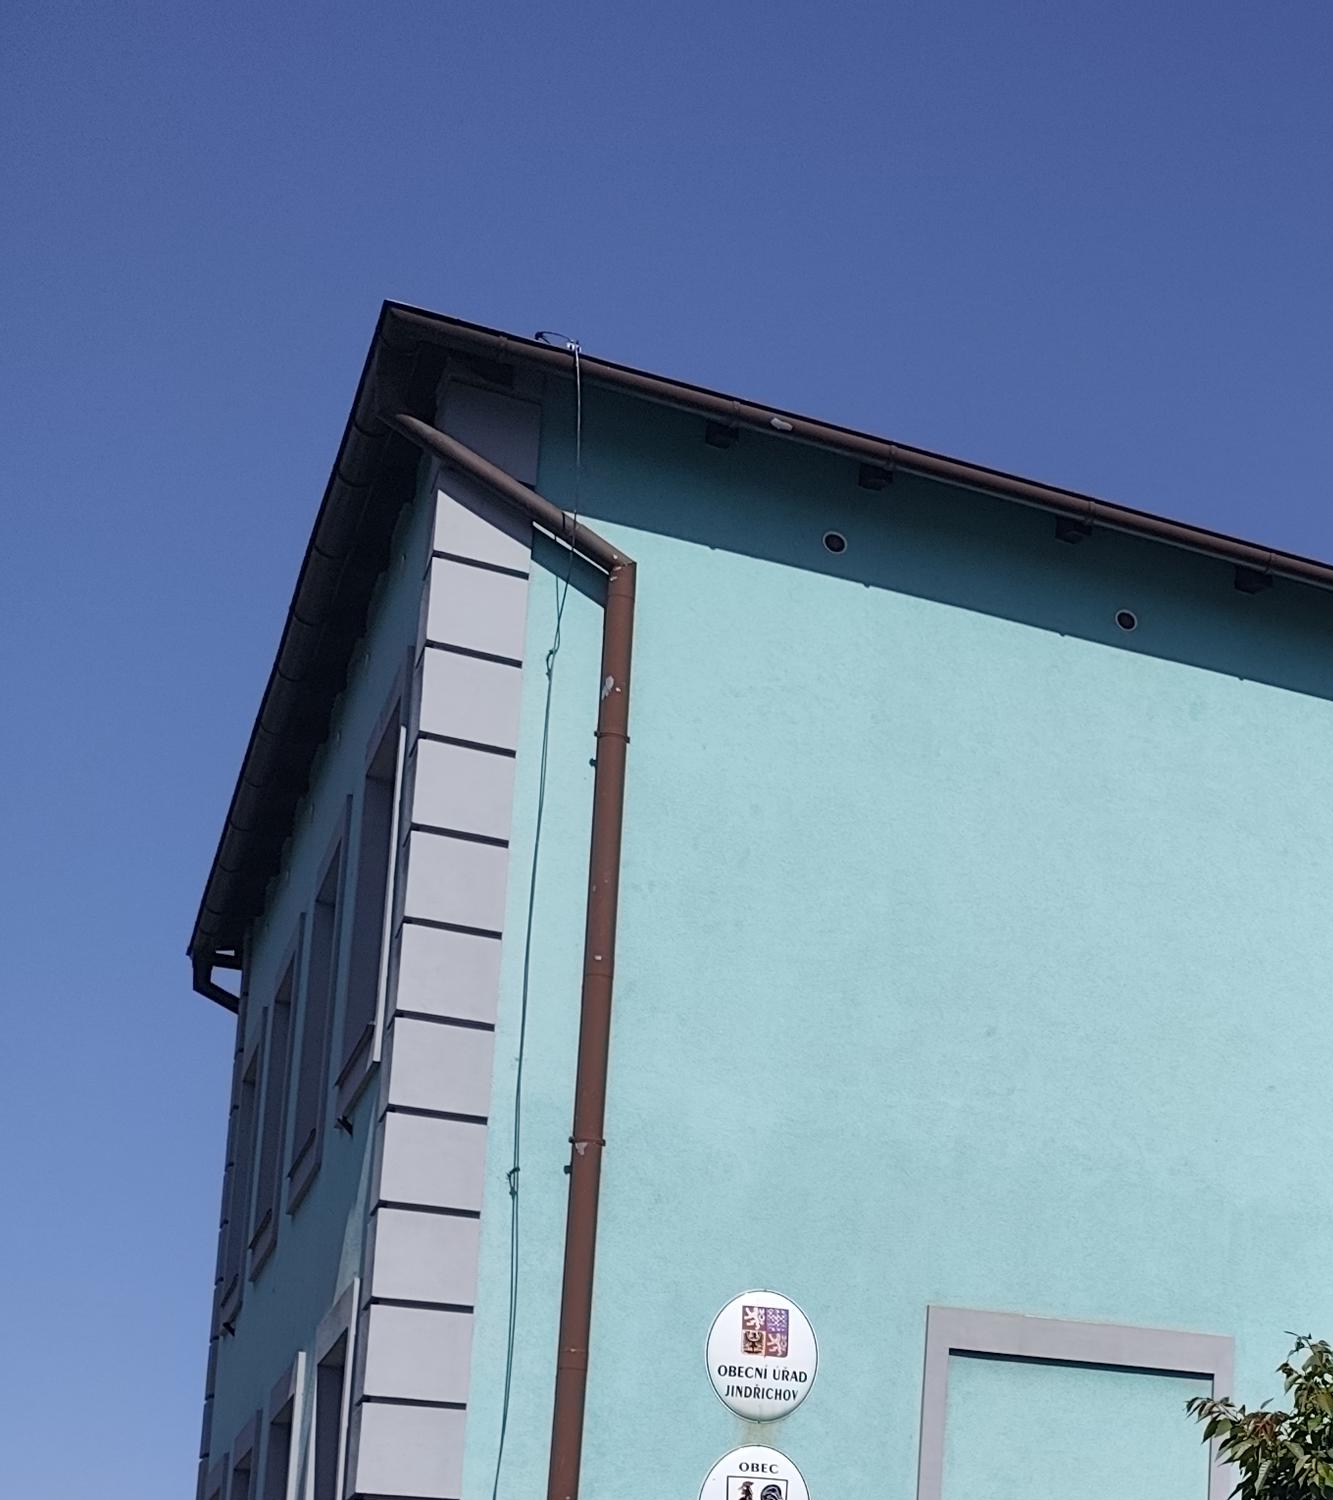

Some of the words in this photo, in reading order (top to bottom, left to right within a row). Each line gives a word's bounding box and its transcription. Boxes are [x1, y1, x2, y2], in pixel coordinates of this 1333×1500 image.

[717, 1363, 768, 1380] OBECNÍ
[772, 1365, 808, 1383] ÚŘAD
[725, 1383, 799, 1401] JINDŘICHOV
[738, 1461, 780, 1474] OBEC
